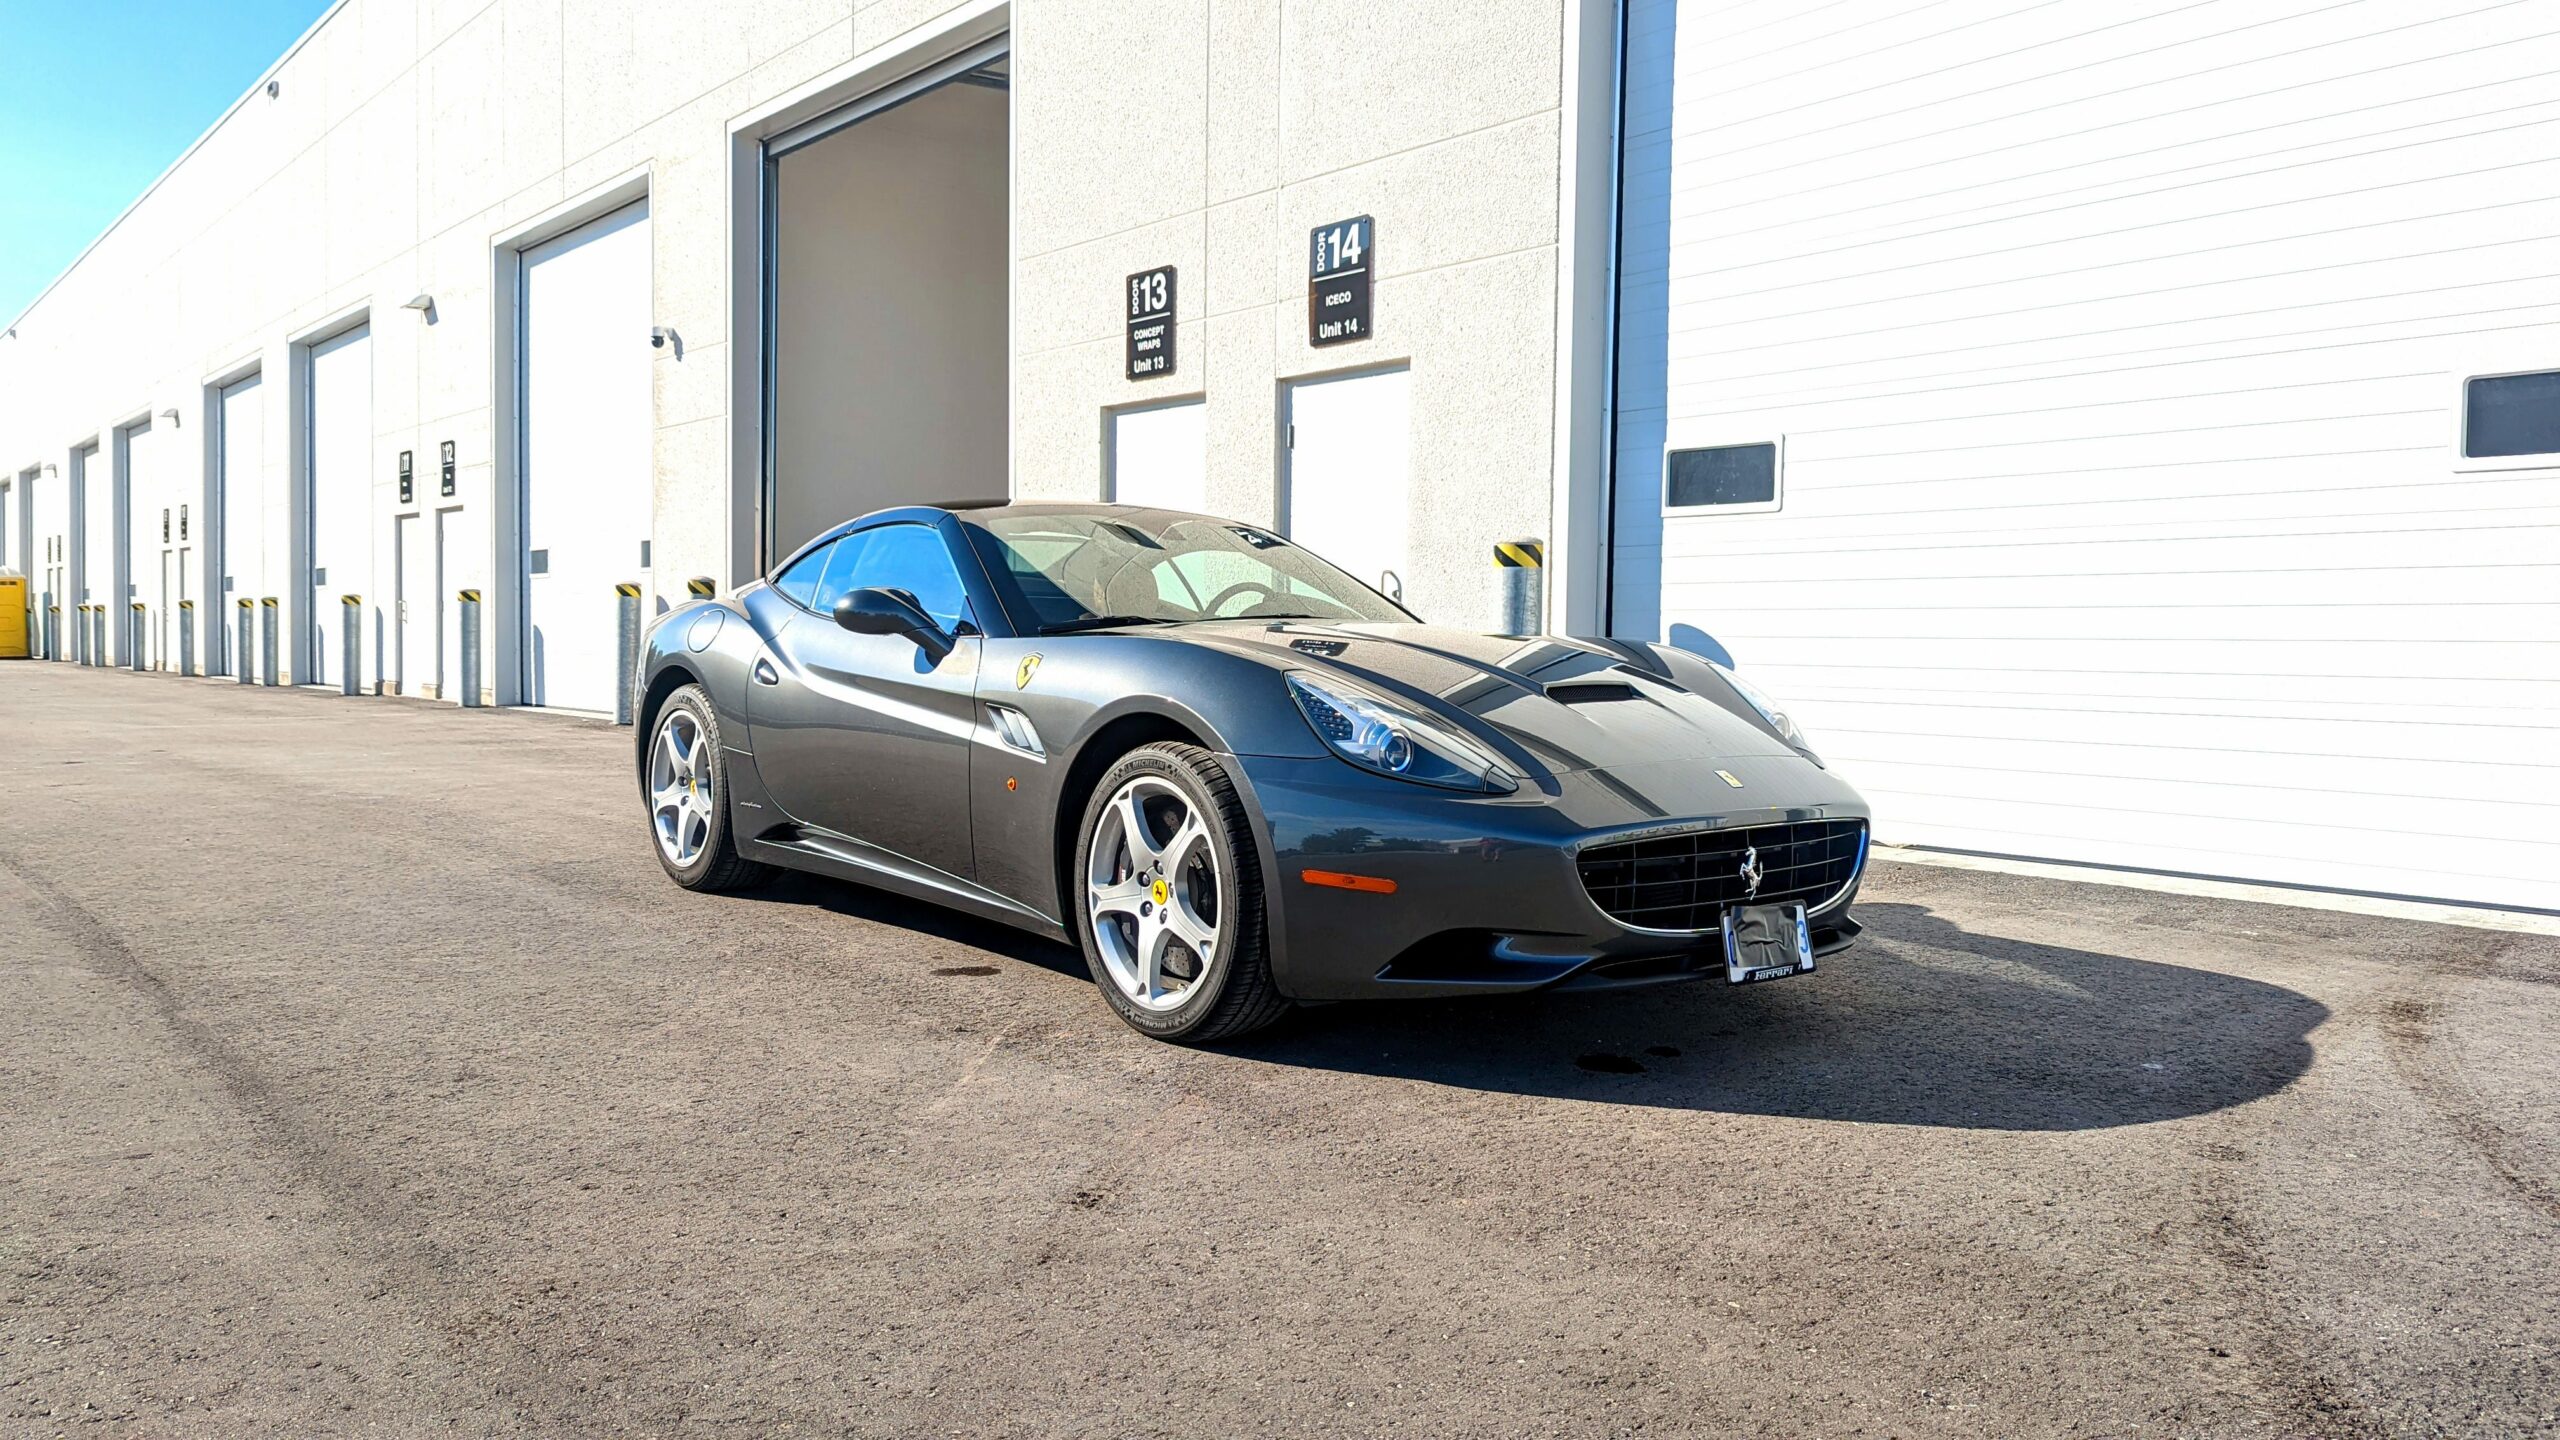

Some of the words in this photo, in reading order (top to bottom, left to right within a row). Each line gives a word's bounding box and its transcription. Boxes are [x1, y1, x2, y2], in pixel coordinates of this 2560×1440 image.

[1317, 231, 1326, 272] DOOR
[1327, 223, 1362, 269] 14
[1140, 272, 1167, 312] 13
[1325, 291, 1352, 307] ICECO
[1133, 324, 1164, 340] CONCEPT
[1319, 321, 1342, 339] Unit
[1344, 317, 1358, 334] 14
[1137, 338, 1161, 351] WRAPS
[1133, 357, 1152, 373] Unit
[1153, 355, 1164, 370] 13
[445, 443, 453, 462] 12
[1754, 967, 1793, 981] Ferrari
